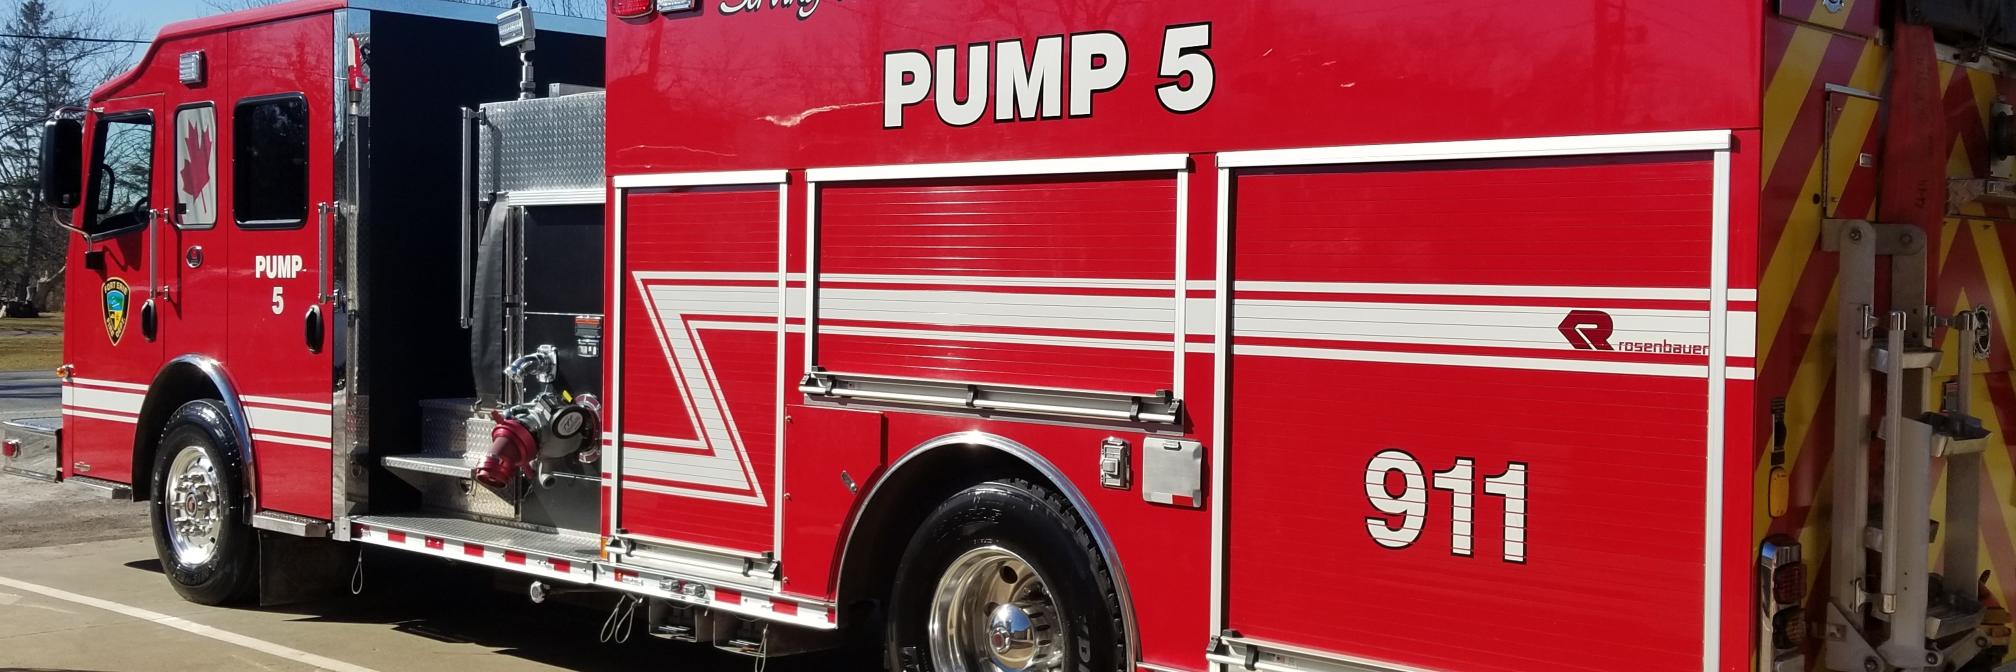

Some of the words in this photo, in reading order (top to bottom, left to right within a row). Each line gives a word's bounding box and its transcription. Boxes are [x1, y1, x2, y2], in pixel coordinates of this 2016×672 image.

[882, 30, 1129, 130] PUMP
[1154, 20, 1216, 115] 5
[255, 254, 303, 279] PUMP
[271, 286, 285, 315] 5
[1618, 338, 1710, 355] rosenbauer
[1363, 448, 1529, 564] 911
